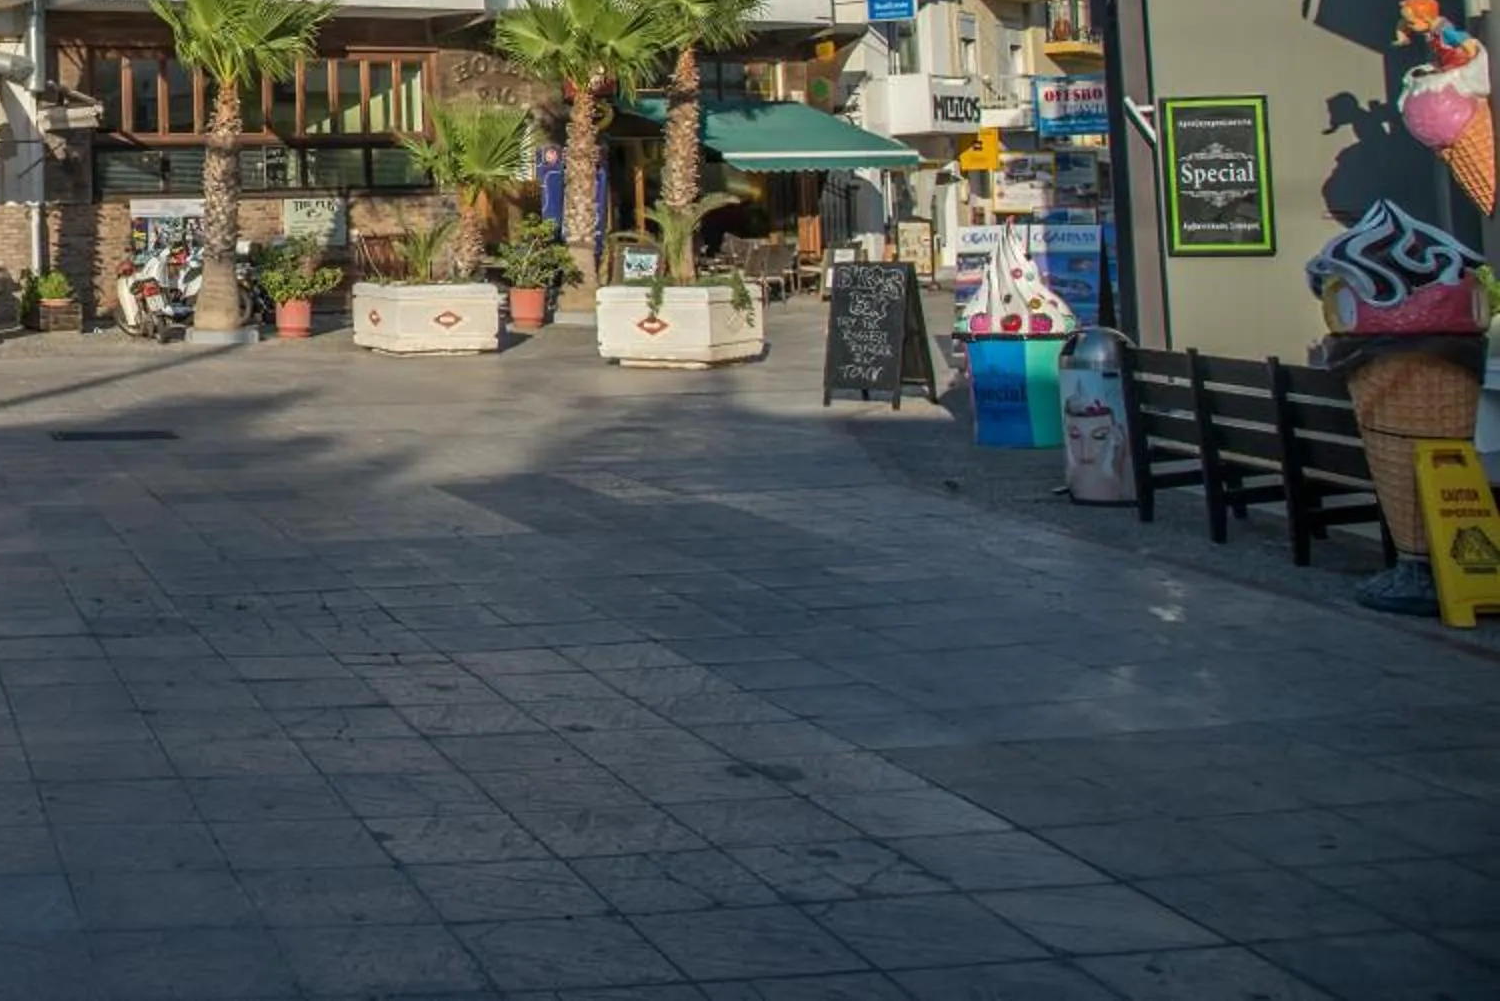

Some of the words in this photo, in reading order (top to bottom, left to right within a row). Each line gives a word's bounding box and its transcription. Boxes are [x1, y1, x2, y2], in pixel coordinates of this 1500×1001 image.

[1043, 86, 1104, 103] OFFSHO
[1180, 161, 1255, 189] Special
[1033, 231, 1097, 245] COMPASS
